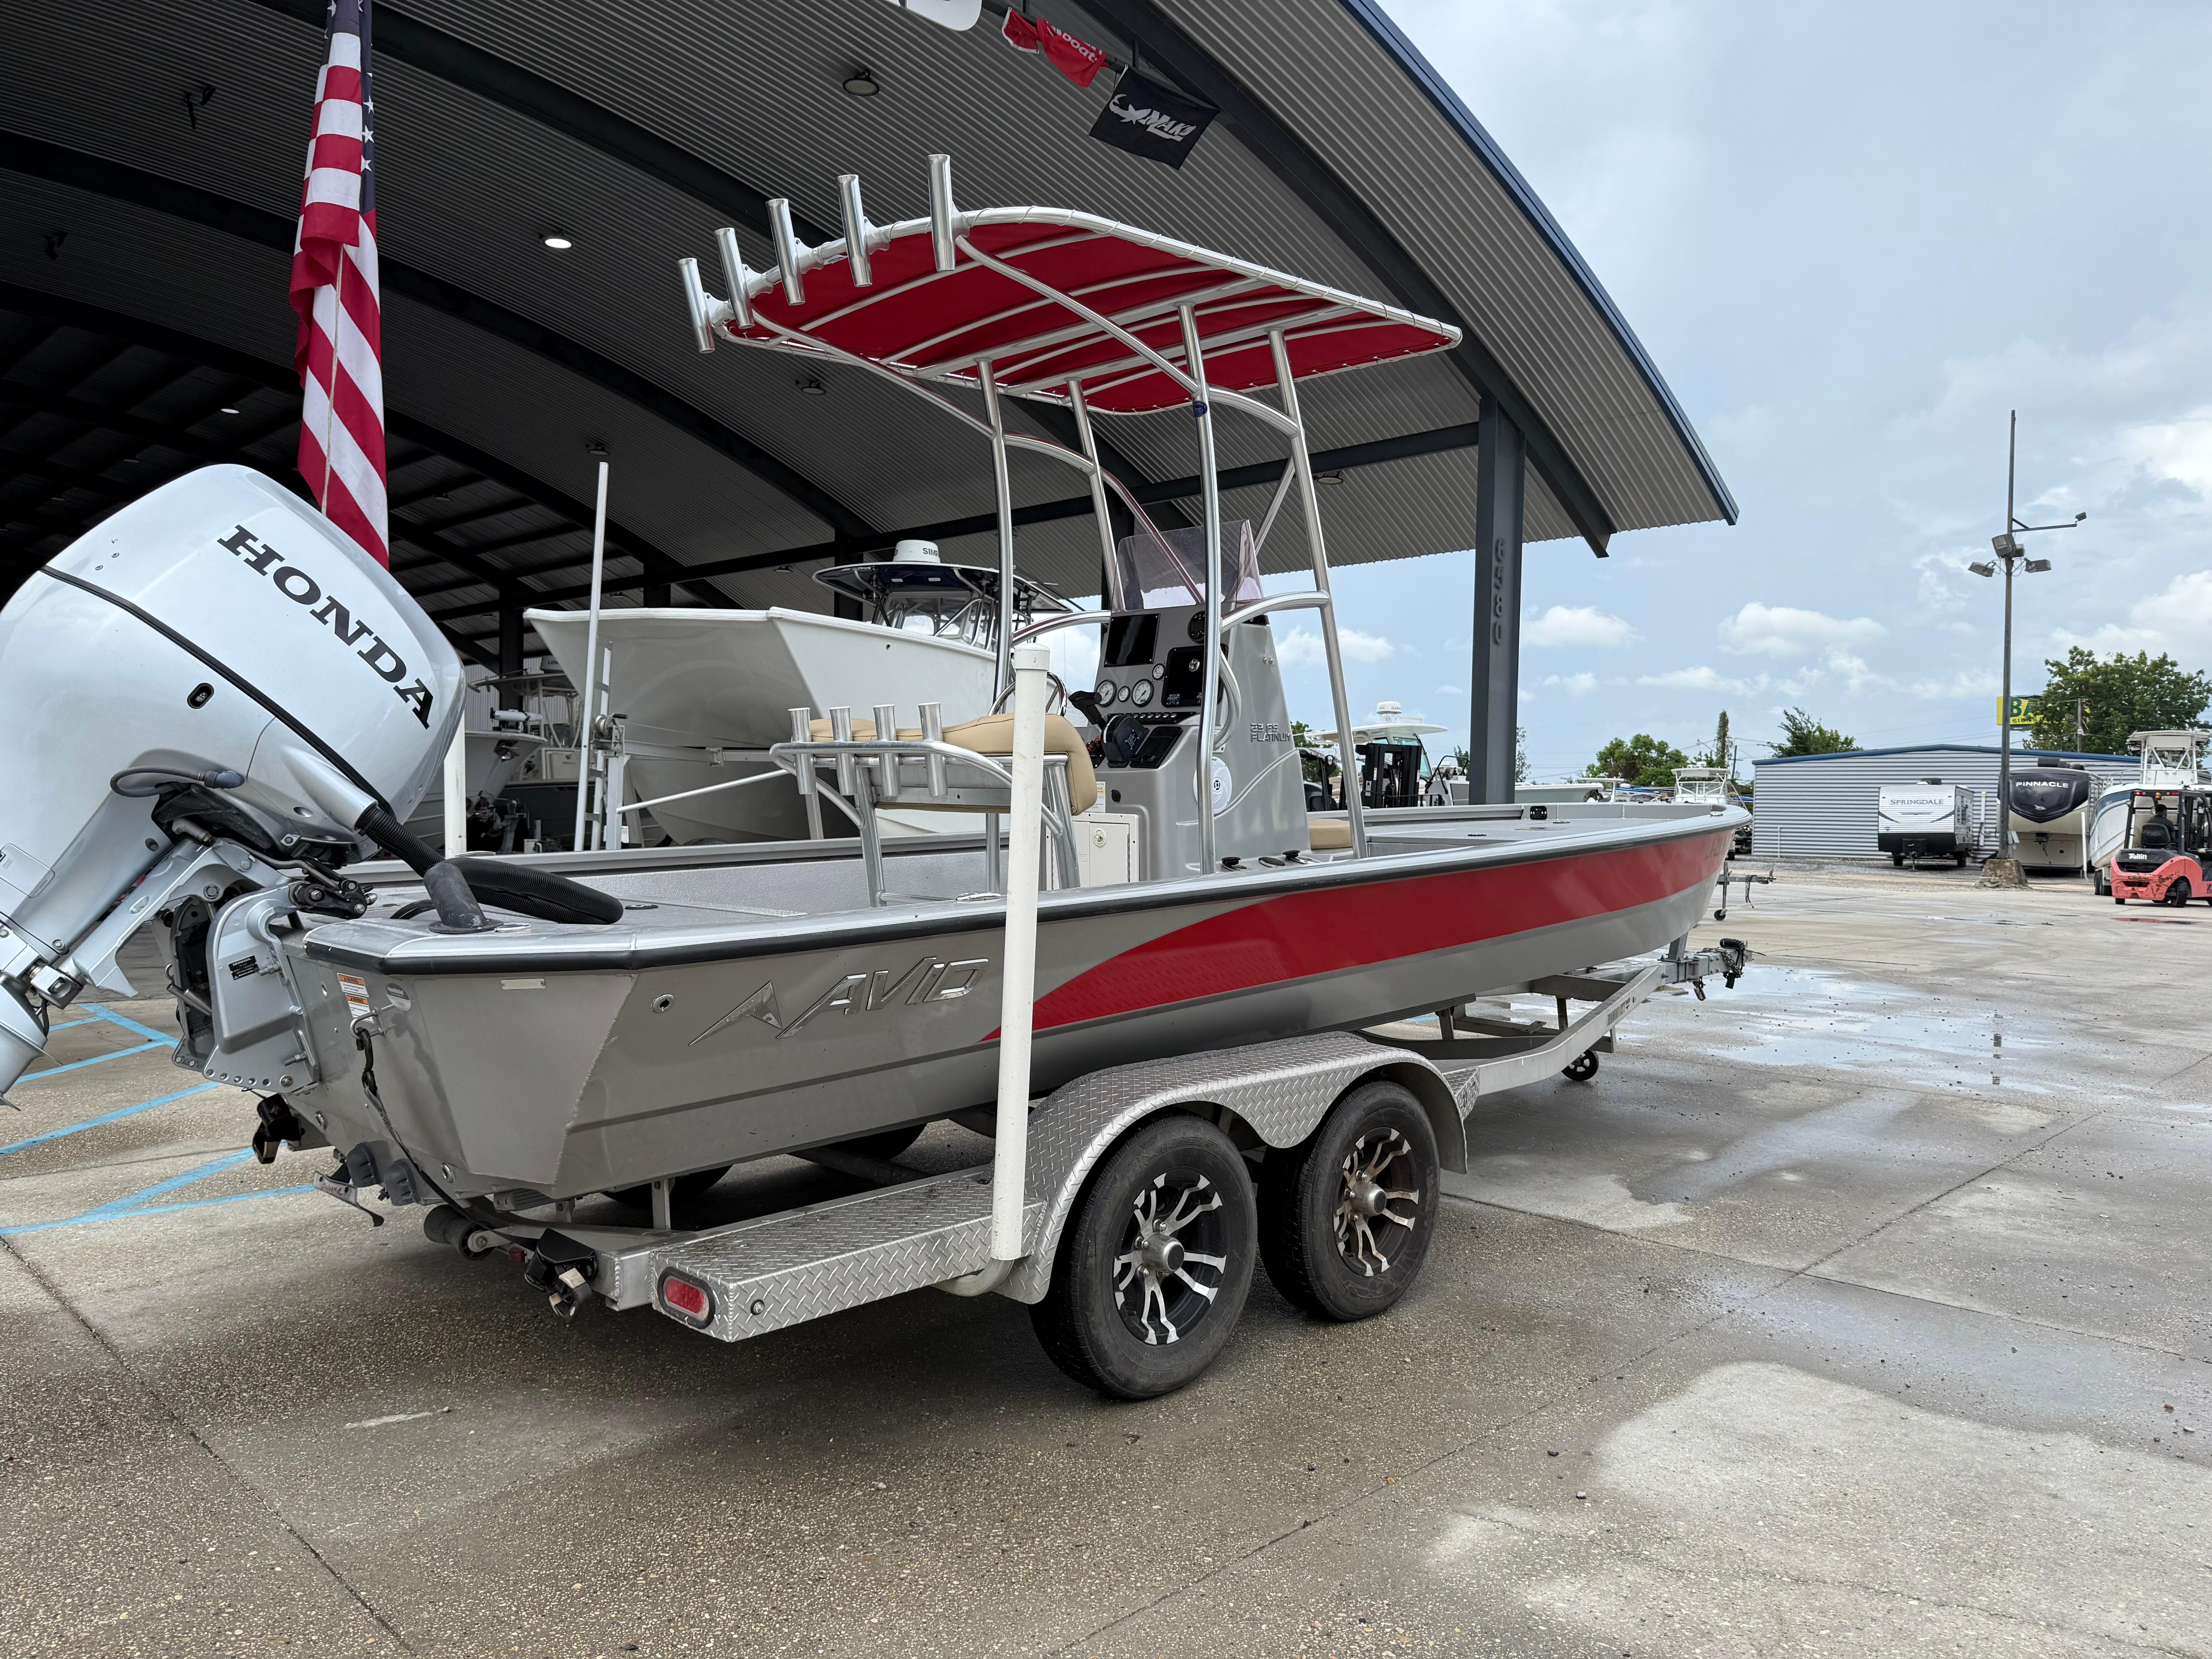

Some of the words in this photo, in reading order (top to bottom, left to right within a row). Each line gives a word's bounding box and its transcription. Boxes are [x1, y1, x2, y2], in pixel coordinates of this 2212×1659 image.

[1137, 110, 1197, 142] MAKO
[217, 524, 433, 730] HONDA
[1250, 723, 1264, 732] 23
[1250, 733, 1290, 742] PLATINUM
[776, 957, 989, 1039] AVID
